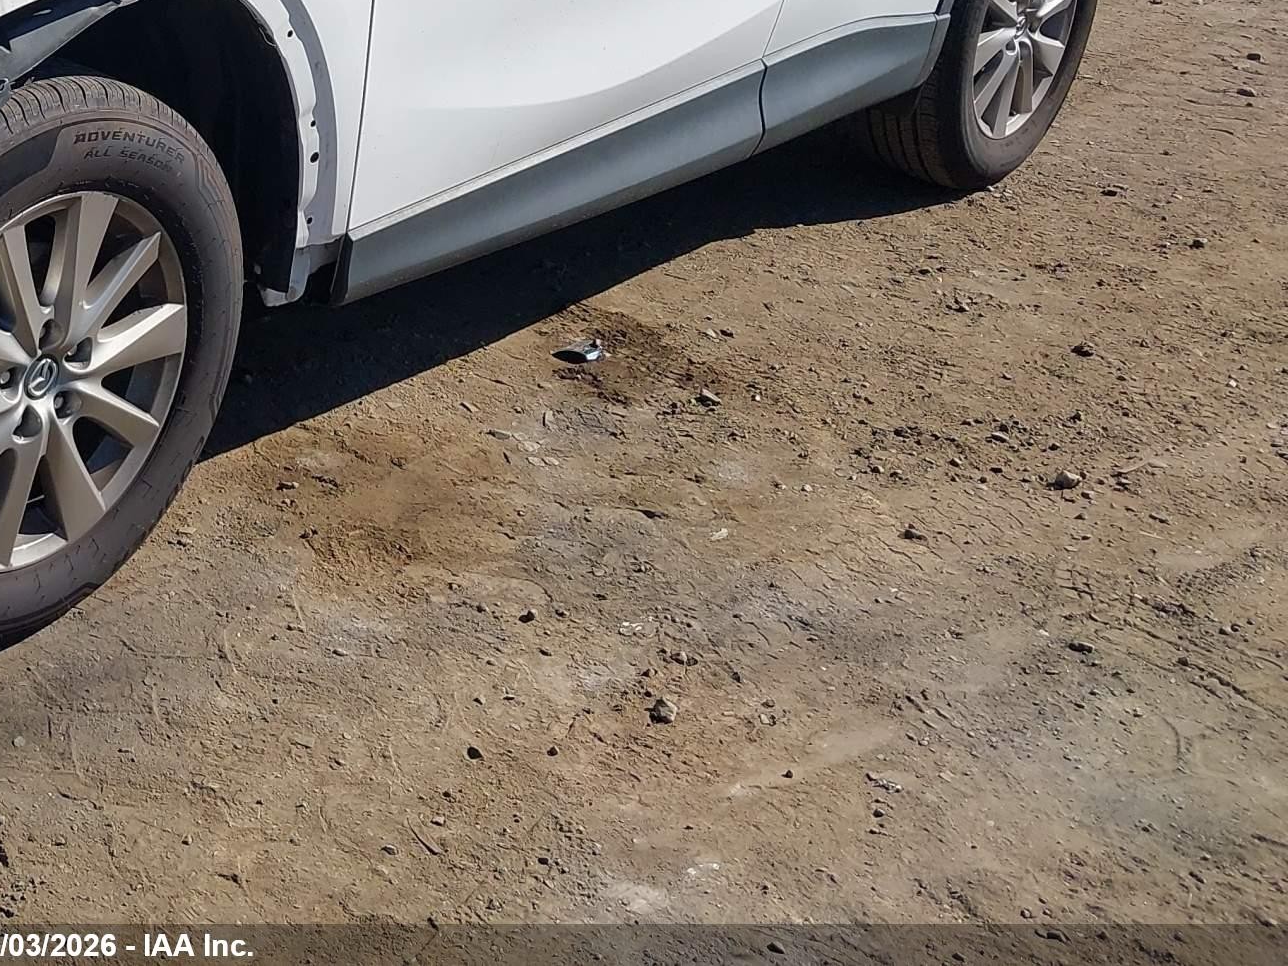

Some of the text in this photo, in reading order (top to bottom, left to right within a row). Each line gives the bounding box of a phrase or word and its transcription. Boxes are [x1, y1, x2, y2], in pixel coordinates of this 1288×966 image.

[73, 129, 185, 164] ADVENTURER
[84, 148, 174, 171] ALL SEASON
